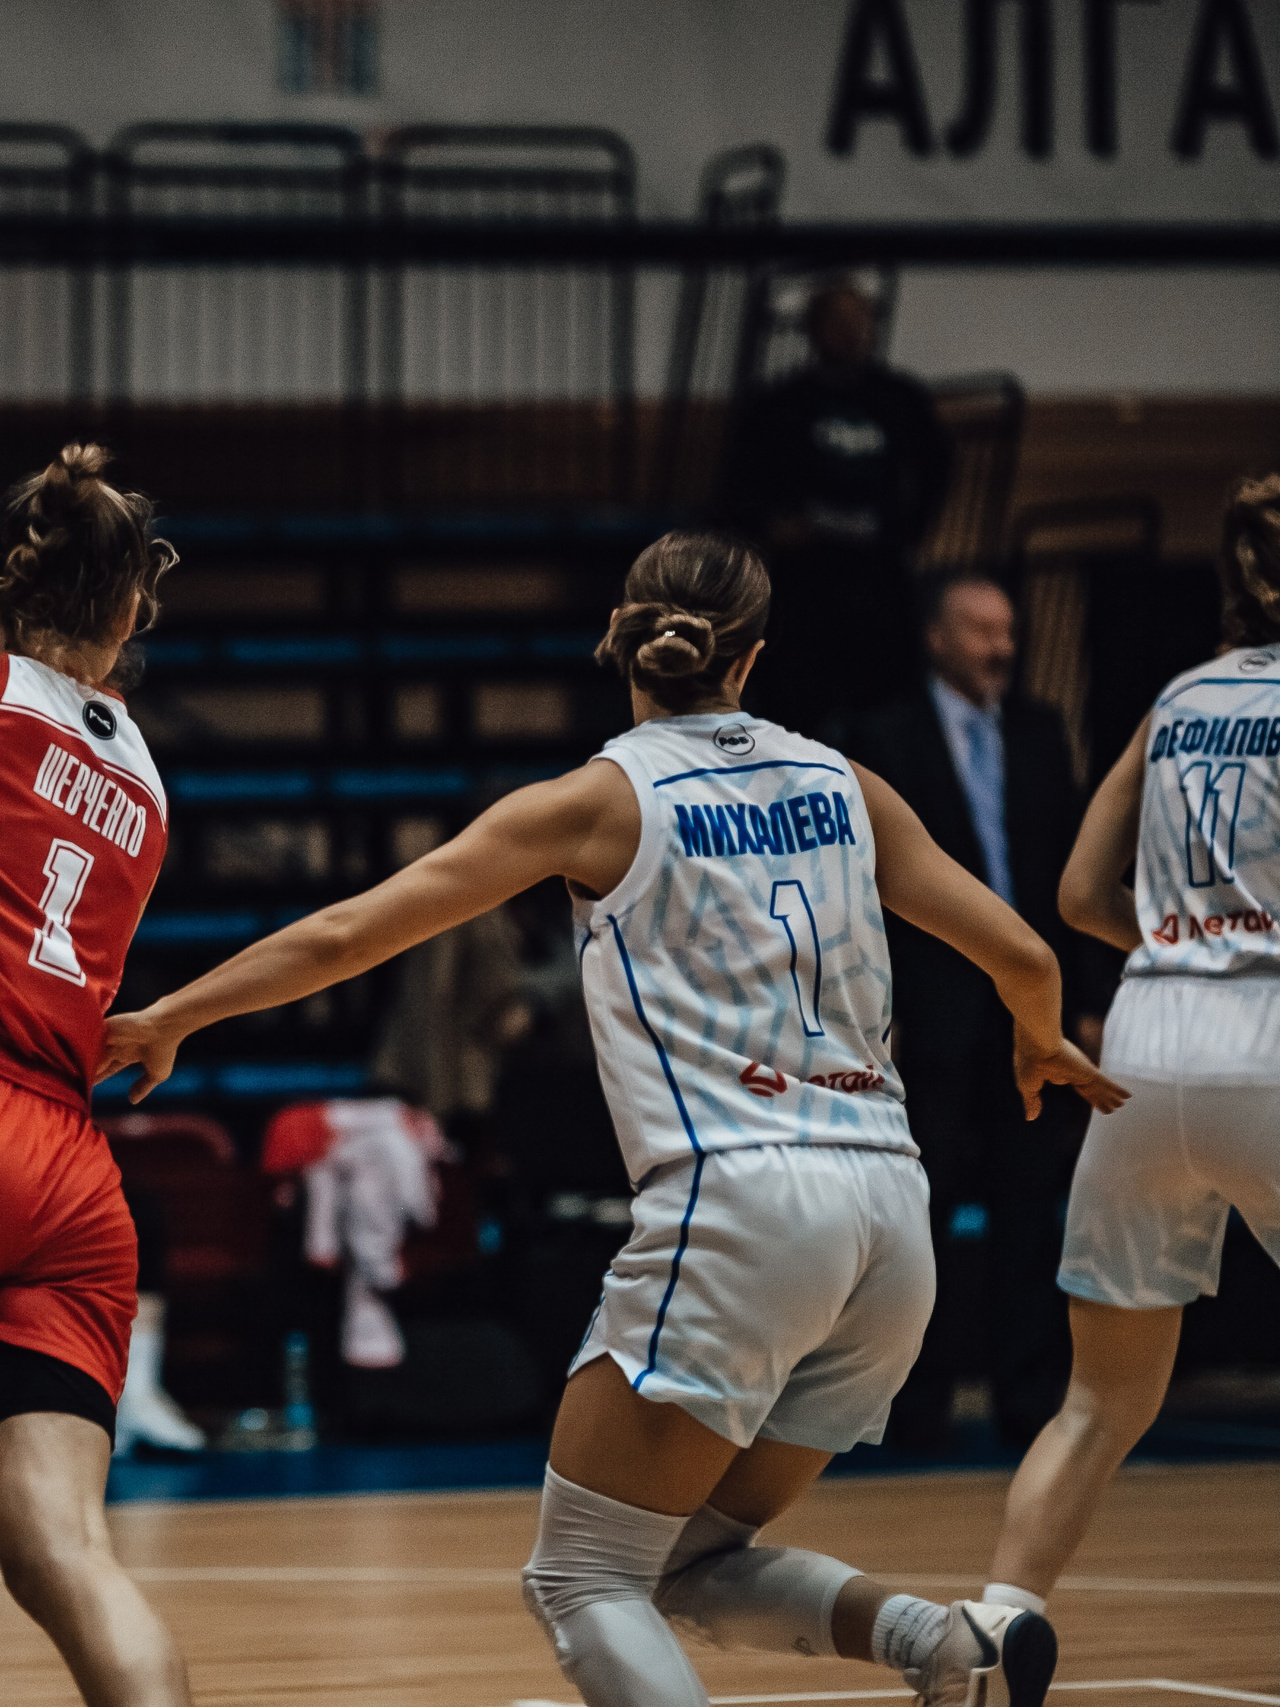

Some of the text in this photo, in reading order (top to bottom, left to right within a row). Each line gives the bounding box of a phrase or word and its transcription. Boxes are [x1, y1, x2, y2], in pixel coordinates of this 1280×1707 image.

[33, 742, 147, 858] ШЕВЧЕНКО
[674, 791, 856, 857] МИХАЛЕВА
[1180, 761, 1246, 888] 11
[28, 837, 95, 988] 1
[770, 879, 825, 1037] 1
